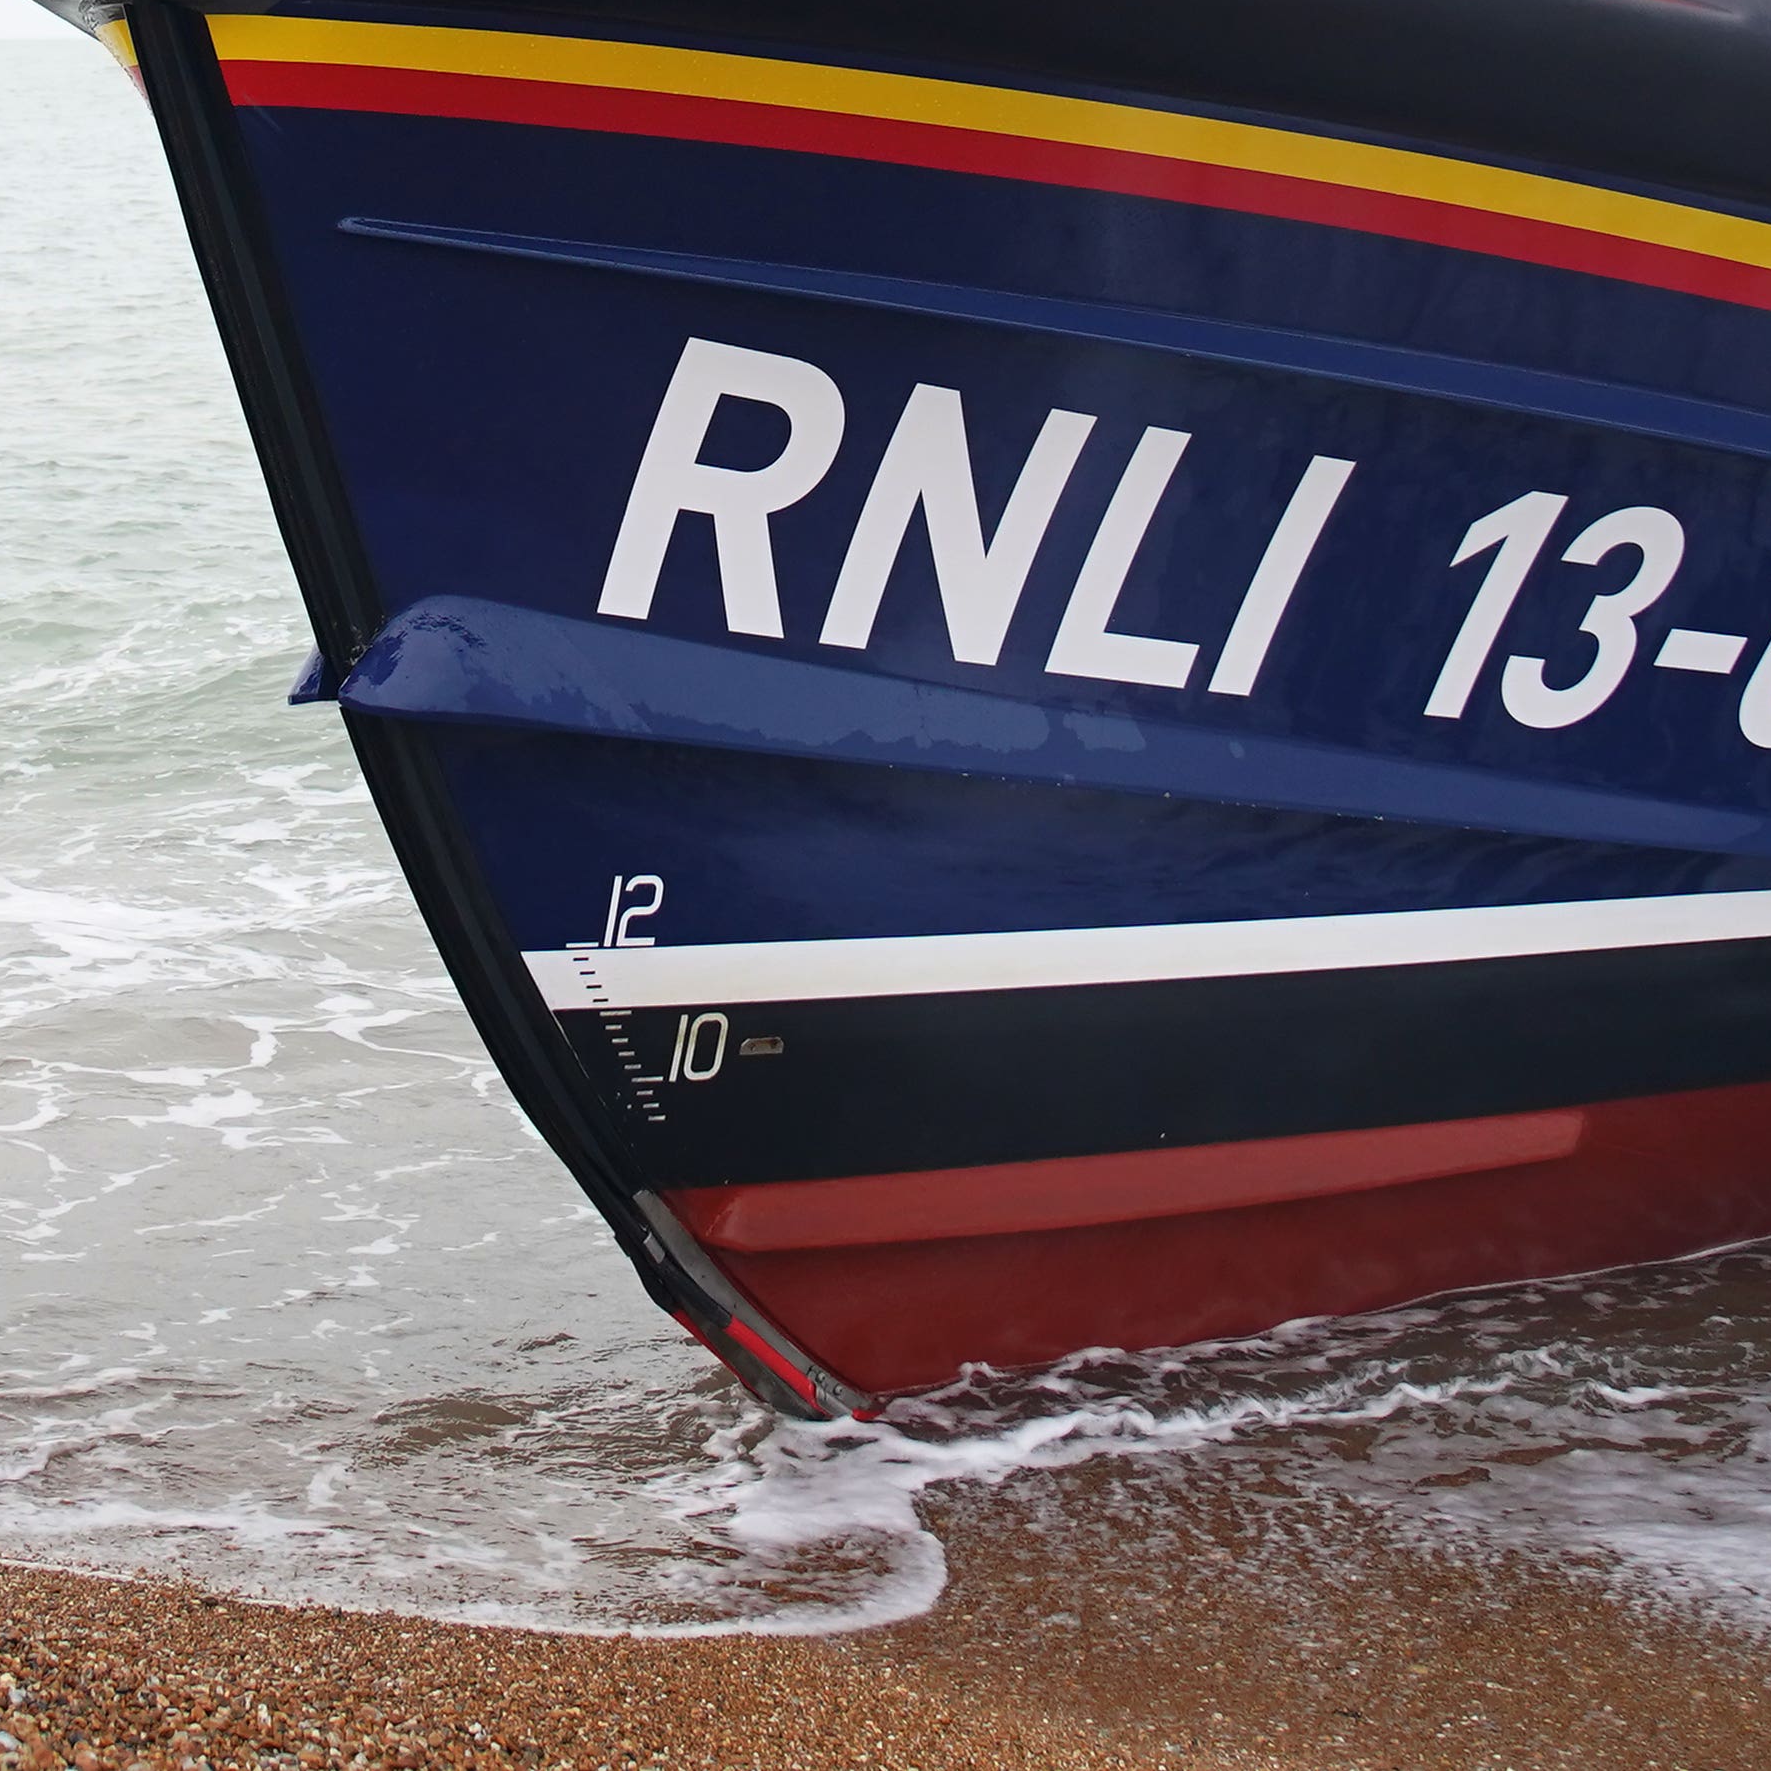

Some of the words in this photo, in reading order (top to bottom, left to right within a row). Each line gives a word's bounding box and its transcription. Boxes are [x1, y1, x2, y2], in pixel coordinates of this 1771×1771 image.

[597, 337, 1357, 697] RNLI
[603, 874, 664, 947] 12
[668, 1012, 729, 1082] 10
